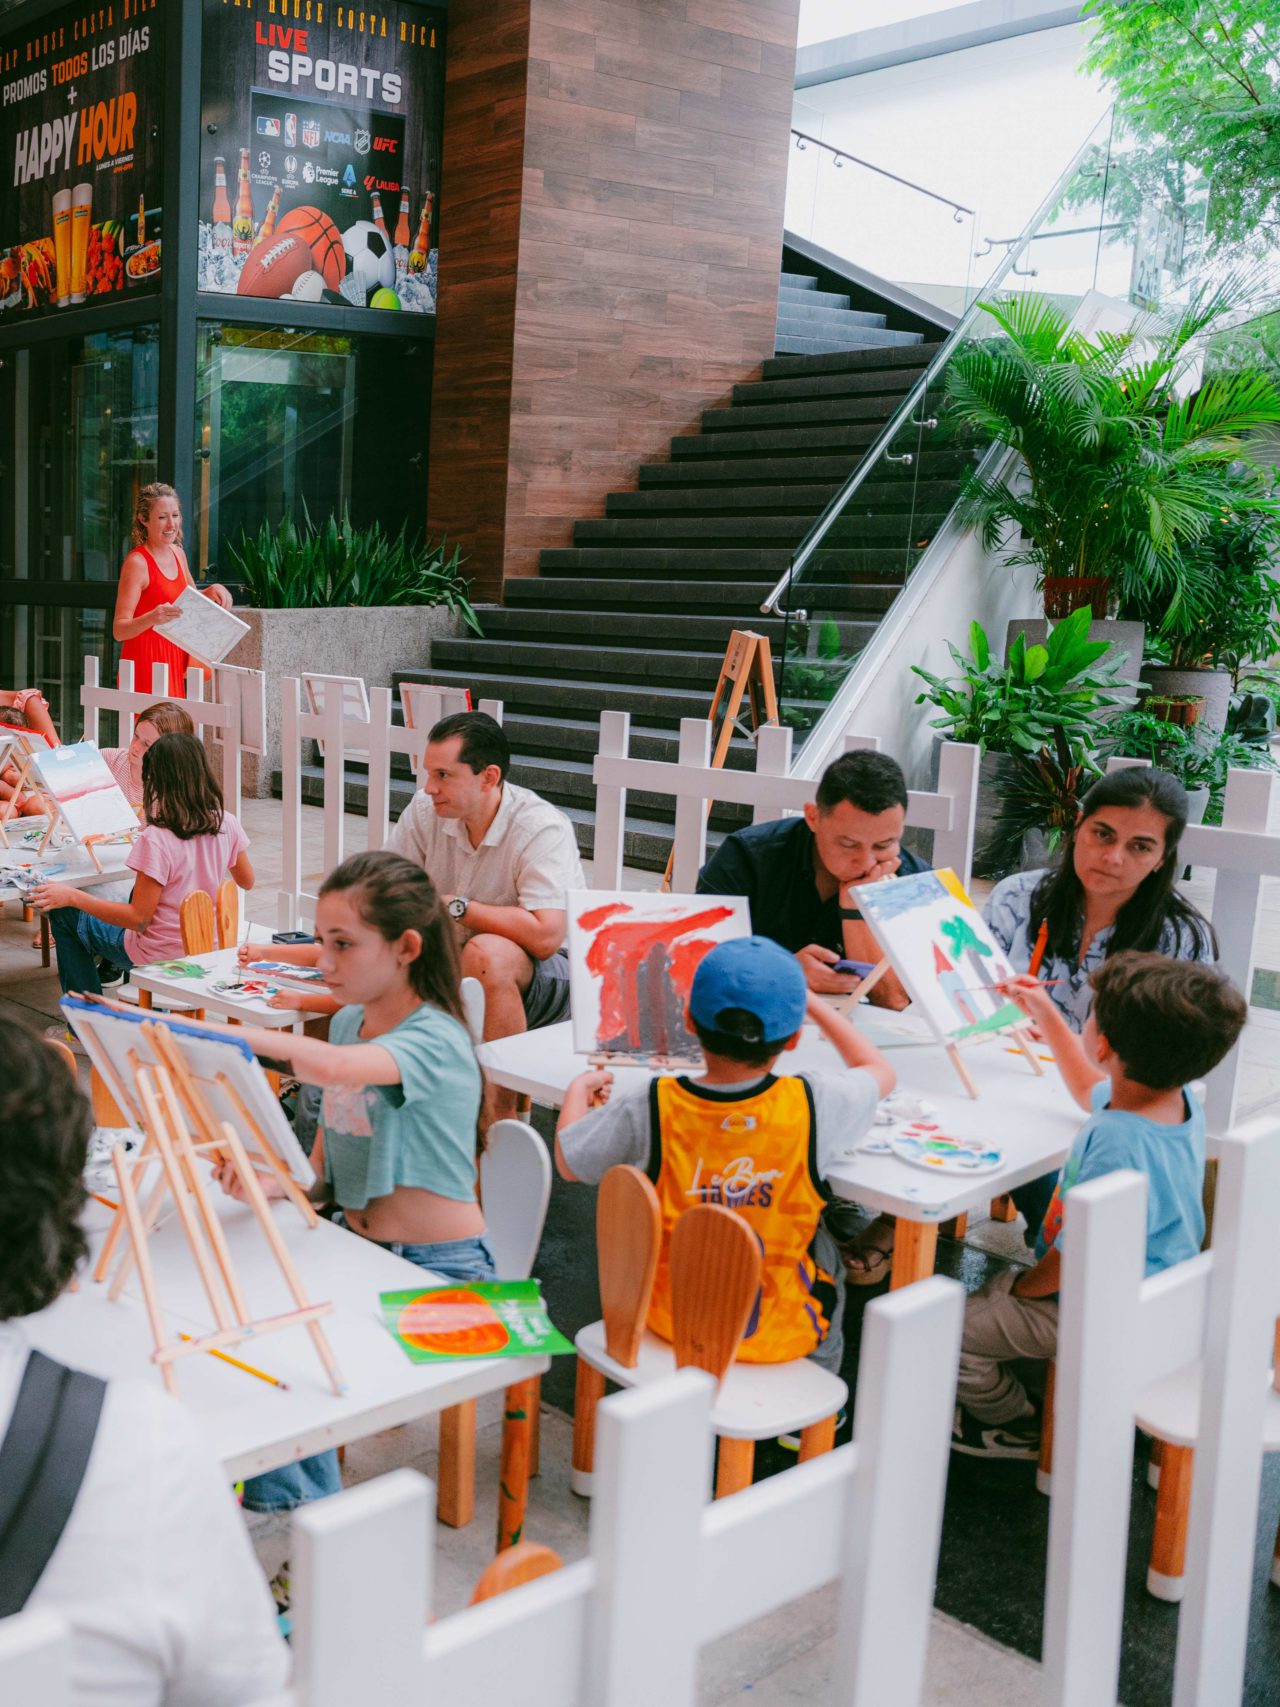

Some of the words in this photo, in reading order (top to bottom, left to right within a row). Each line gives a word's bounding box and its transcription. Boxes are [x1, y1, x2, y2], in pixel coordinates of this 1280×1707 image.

[26, 28, 65, 62] HOUSE
[74, 6, 113, 41] COSTA
[269, 0, 323, 24] HOUSE
[337, 7, 387, 38] COSTA
[400, 21, 436, 48] RICA
[255, 21, 309, 54] LIVE
[3, 69, 47, 107] PROMOS
[51, 52, 88, 87] TODOS
[91, 40, 115, 71] LOS
[119, 26, 150, 61] DÍAS
[268, 49, 402, 104] SPORTS
[13, 111, 79, 188] HAPPY
[77, 91, 138, 167] HOUR
[324, 130, 352, 146] NCAA
[373, 136, 399, 153] UFC
[95, 160, 111, 171] LUNES
[315, 165, 339, 177] Premier
[315, 174, 339, 186] League
[375, 179, 400, 192] LALIGA
